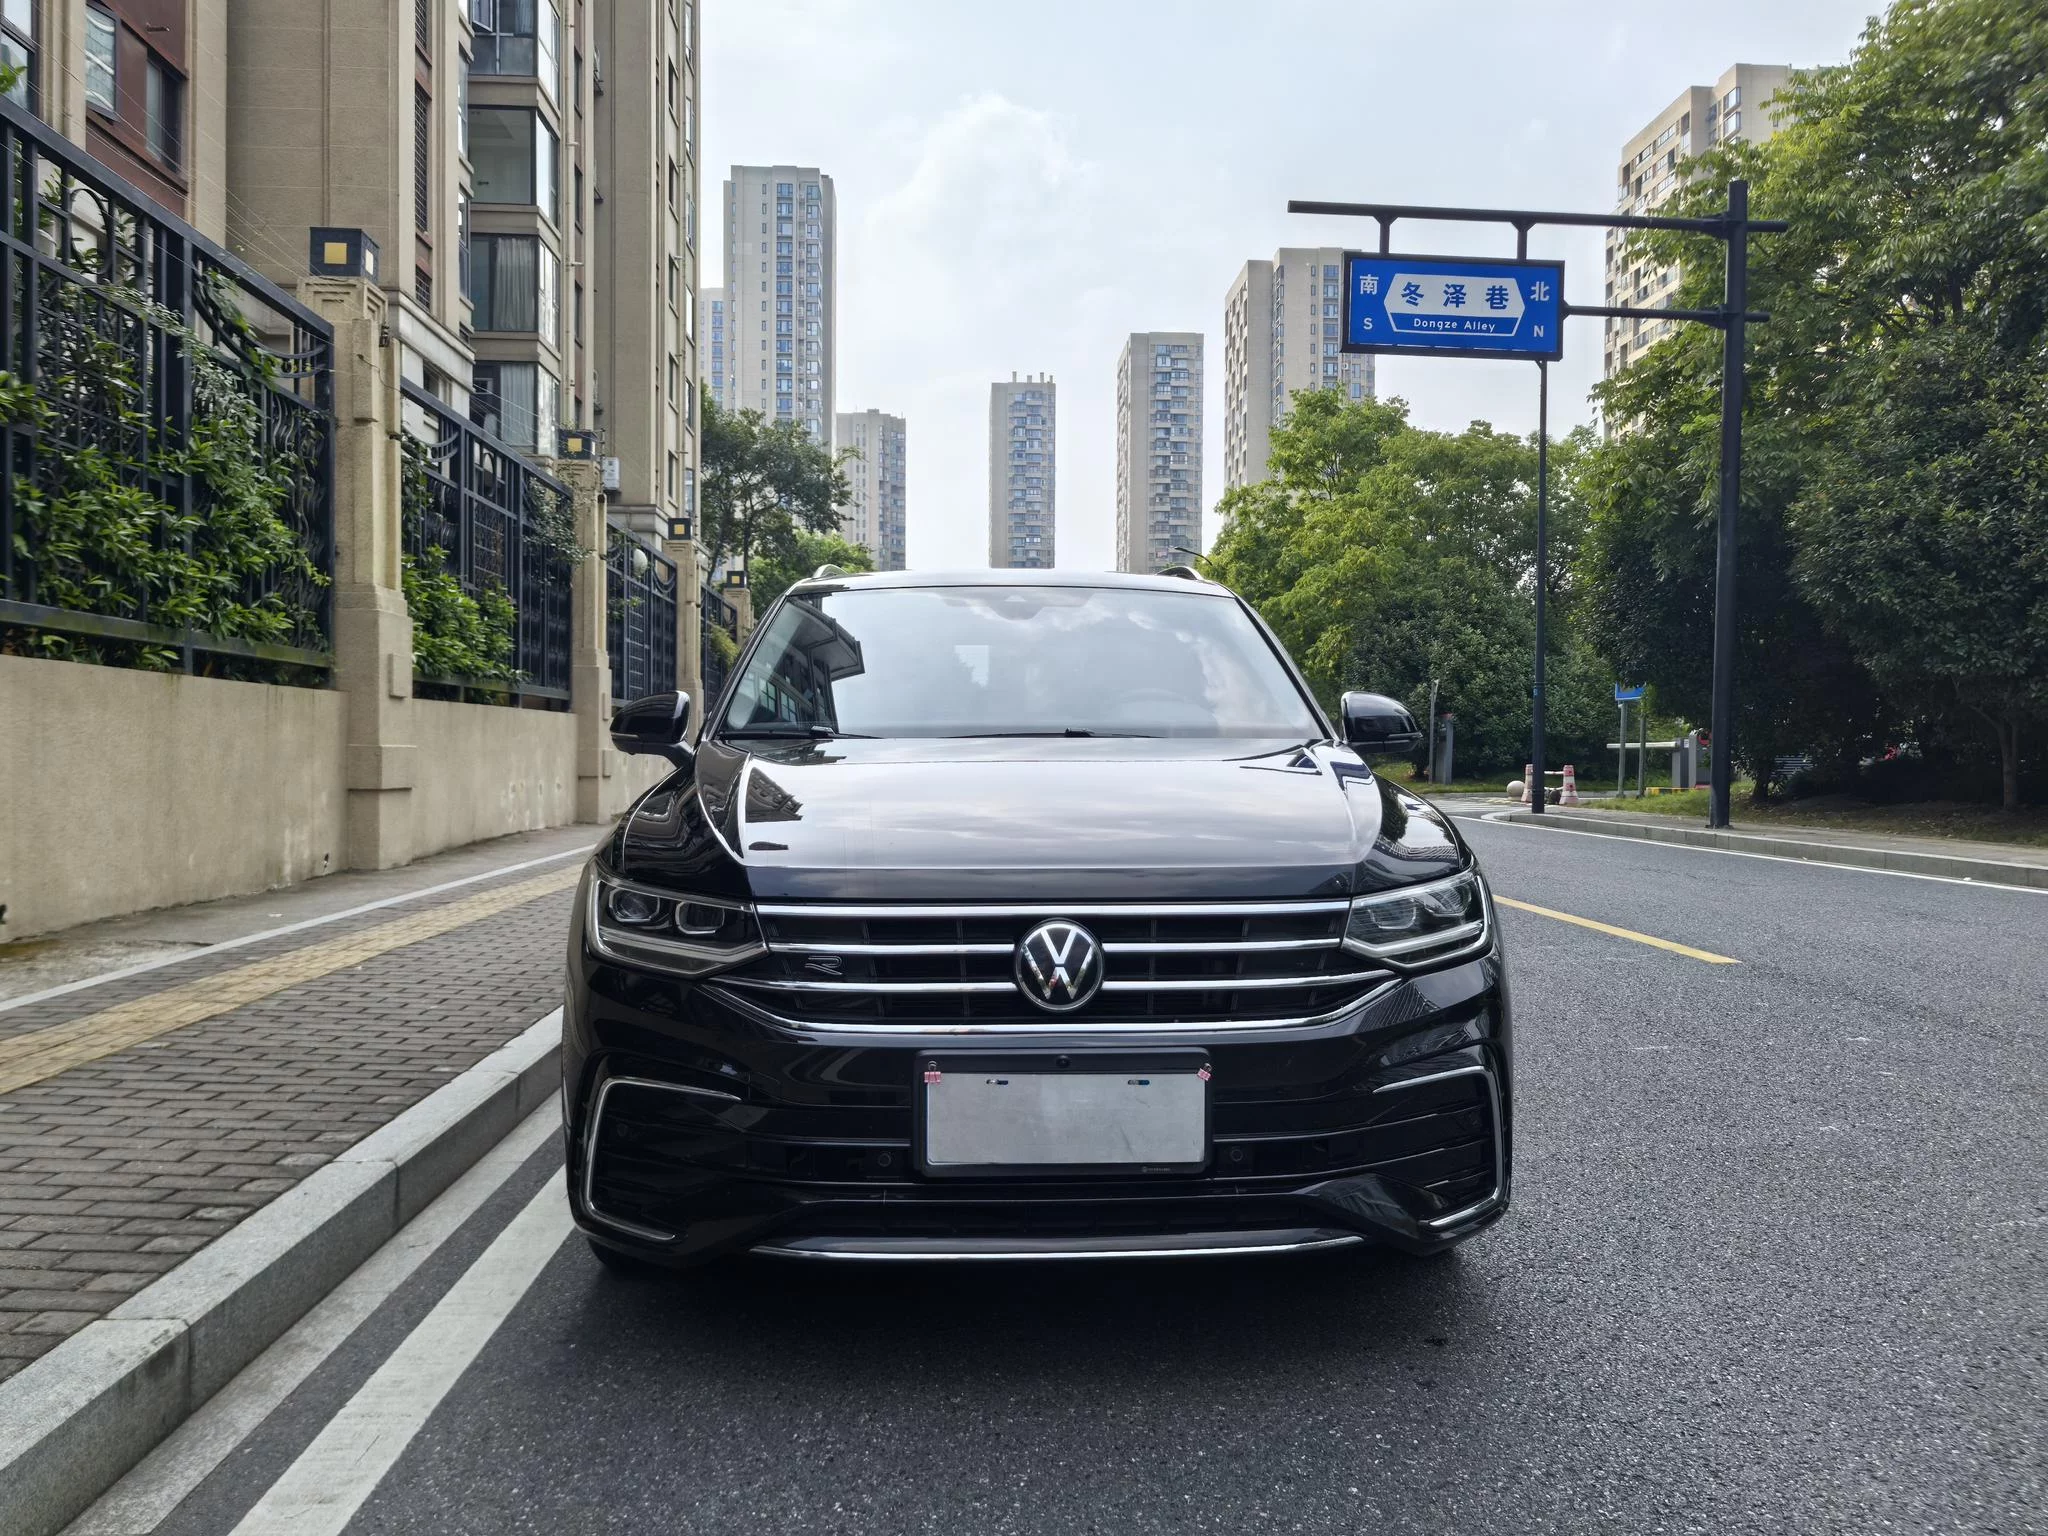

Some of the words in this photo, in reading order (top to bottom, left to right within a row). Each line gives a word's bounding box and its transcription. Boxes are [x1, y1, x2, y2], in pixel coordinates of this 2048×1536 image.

[1359, 274, 1379, 295] 南
[1530, 281, 1550, 302] 北
[1401, 281, 1509, 310] 冬泽巷
[1363, 317, 1373, 330] S
[1413, 318, 1458, 330] Dongze
[1464, 321, 1496, 333] Alley
[1533, 325, 1544, 338] N
